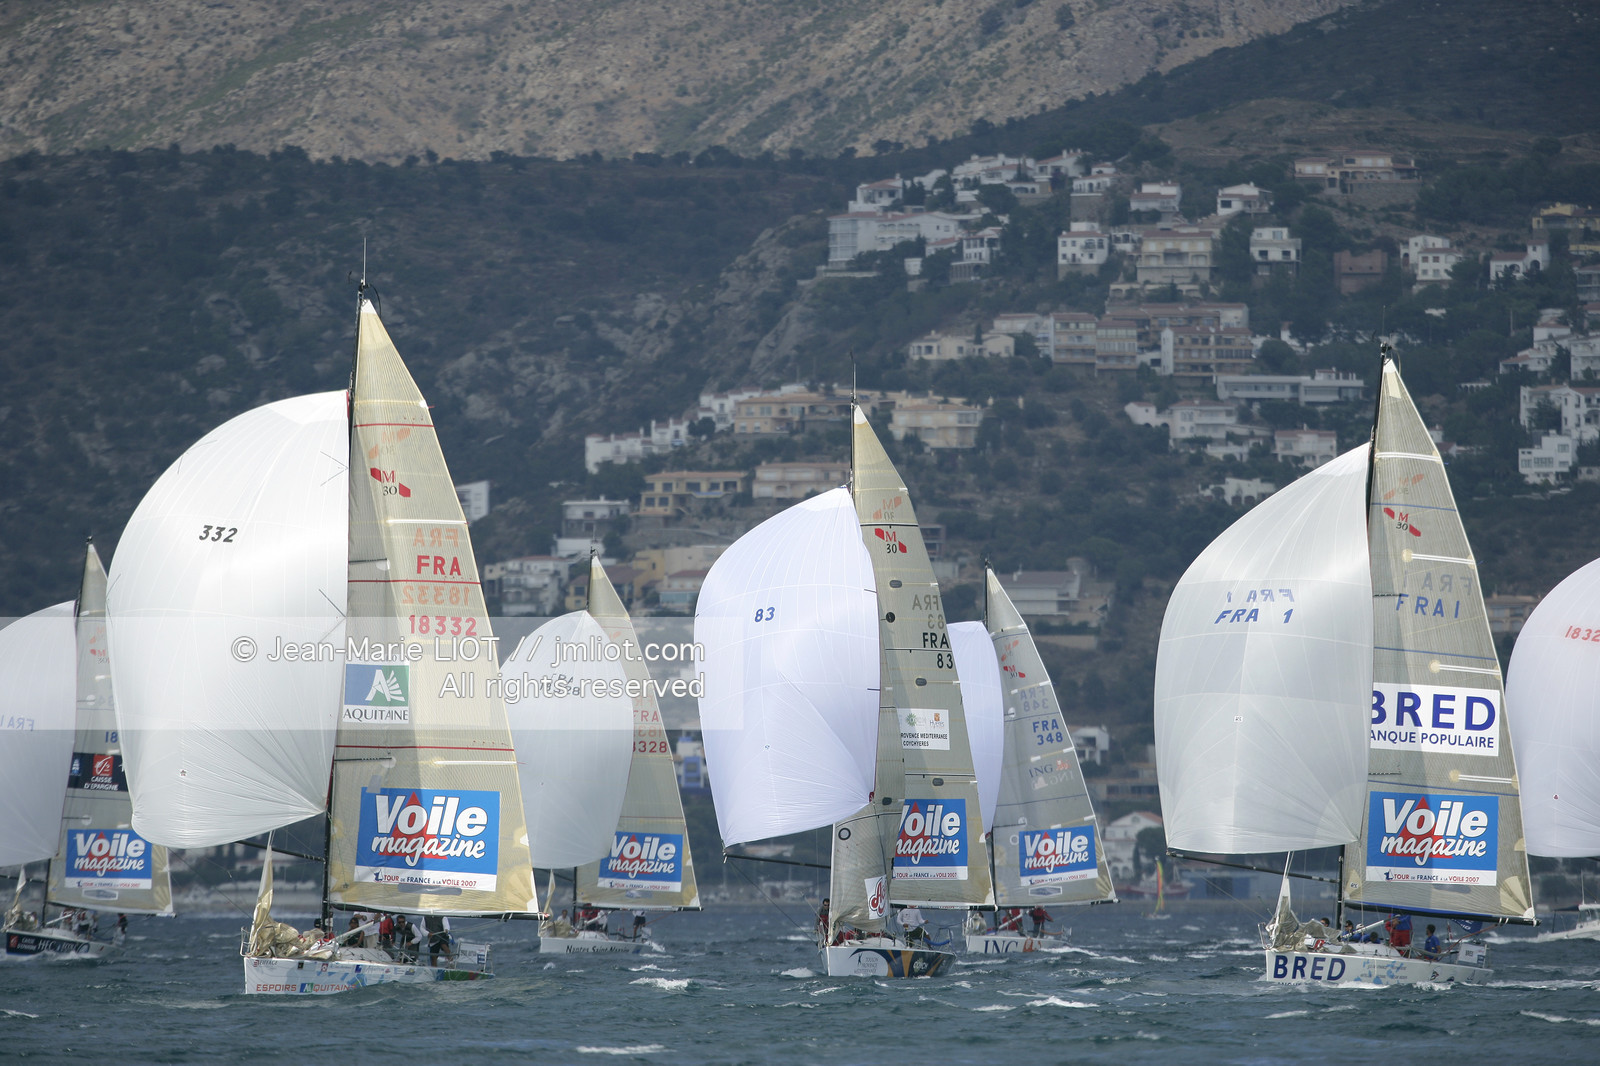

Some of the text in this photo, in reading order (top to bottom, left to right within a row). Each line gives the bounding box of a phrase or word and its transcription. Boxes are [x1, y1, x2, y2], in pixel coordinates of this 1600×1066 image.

[382, 470, 395, 483] M
[383, 486, 397, 496] 30
[1398, 512, 1409, 523] M
[199, 524, 238, 543] 332
[1396, 522, 1408, 531] 30
[885, 531, 896, 542] M
[886, 543, 898, 554] 30
[417, 555, 461, 575] FRA
[754, 607, 776, 623] 83
[1214, 608, 1294, 624] FRA 1
[409, 615, 477, 636] 18332
[922, 632, 949, 649] FRA
[937, 653, 953, 669] 83
[343, 709, 409, 722] AQUITAINE
[1032, 719, 1059, 733] FRA
[1037, 732, 1063, 745] 348
[1420, 733, 1494, 748] POPULAIRE
[1029, 764, 1053, 778] ING
[376, 794, 488, 837] Voile
[1383, 798, 1488, 837] Voile
[75, 832, 146, 857] Voile
[371, 834, 486, 867] magazine
[610, 835, 676, 860] Voile
[1024, 831, 1088, 857] Voile
[1380, 834, 1487, 866] magazine
[74, 855, 144, 877] magazine
[608, 858, 674, 879] magazine
[1024, 849, 1089, 873] magazine
[407, 876, 431, 884] FRANCE
[1273, 955, 1346, 981] BRED
[256, 984, 297, 992] ESPOIRS
